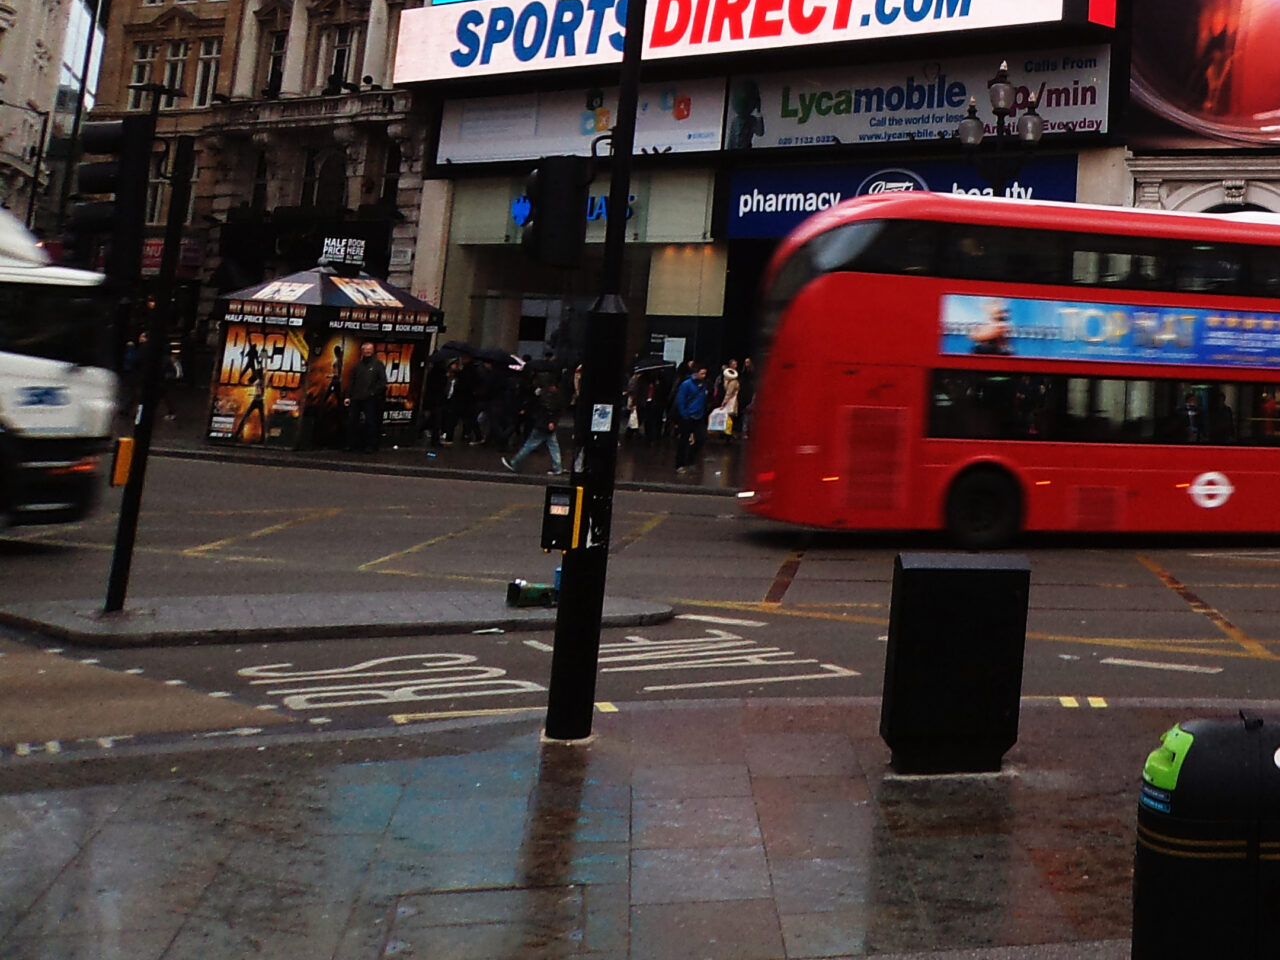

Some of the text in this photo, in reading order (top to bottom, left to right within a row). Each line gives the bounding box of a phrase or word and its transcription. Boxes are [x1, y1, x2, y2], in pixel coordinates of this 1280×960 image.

[1025, 56, 1097, 73] Calls From
[781, 74, 967, 125] Lycamobile
[988, 77, 1097, 117] p/min
[869, 116, 887, 127] Call
[888, 115, 903, 126] the
[904, 114, 930, 125] world
[931, 113, 945, 124] for
[952, 181, 1033, 200] beaty
[739, 188, 841, 218] pharmacy
[324, 237, 347, 247] HALF
[323, 246, 346, 255] PRICE
[346, 247, 365, 256] HERE
[225, 313, 243, 322] HALF
[242, 315, 264, 324] PRICE
[329, 320, 345, 329] HALF
[344, 321, 361, 330] PRICE
[237, 653, 549, 711] BUS
